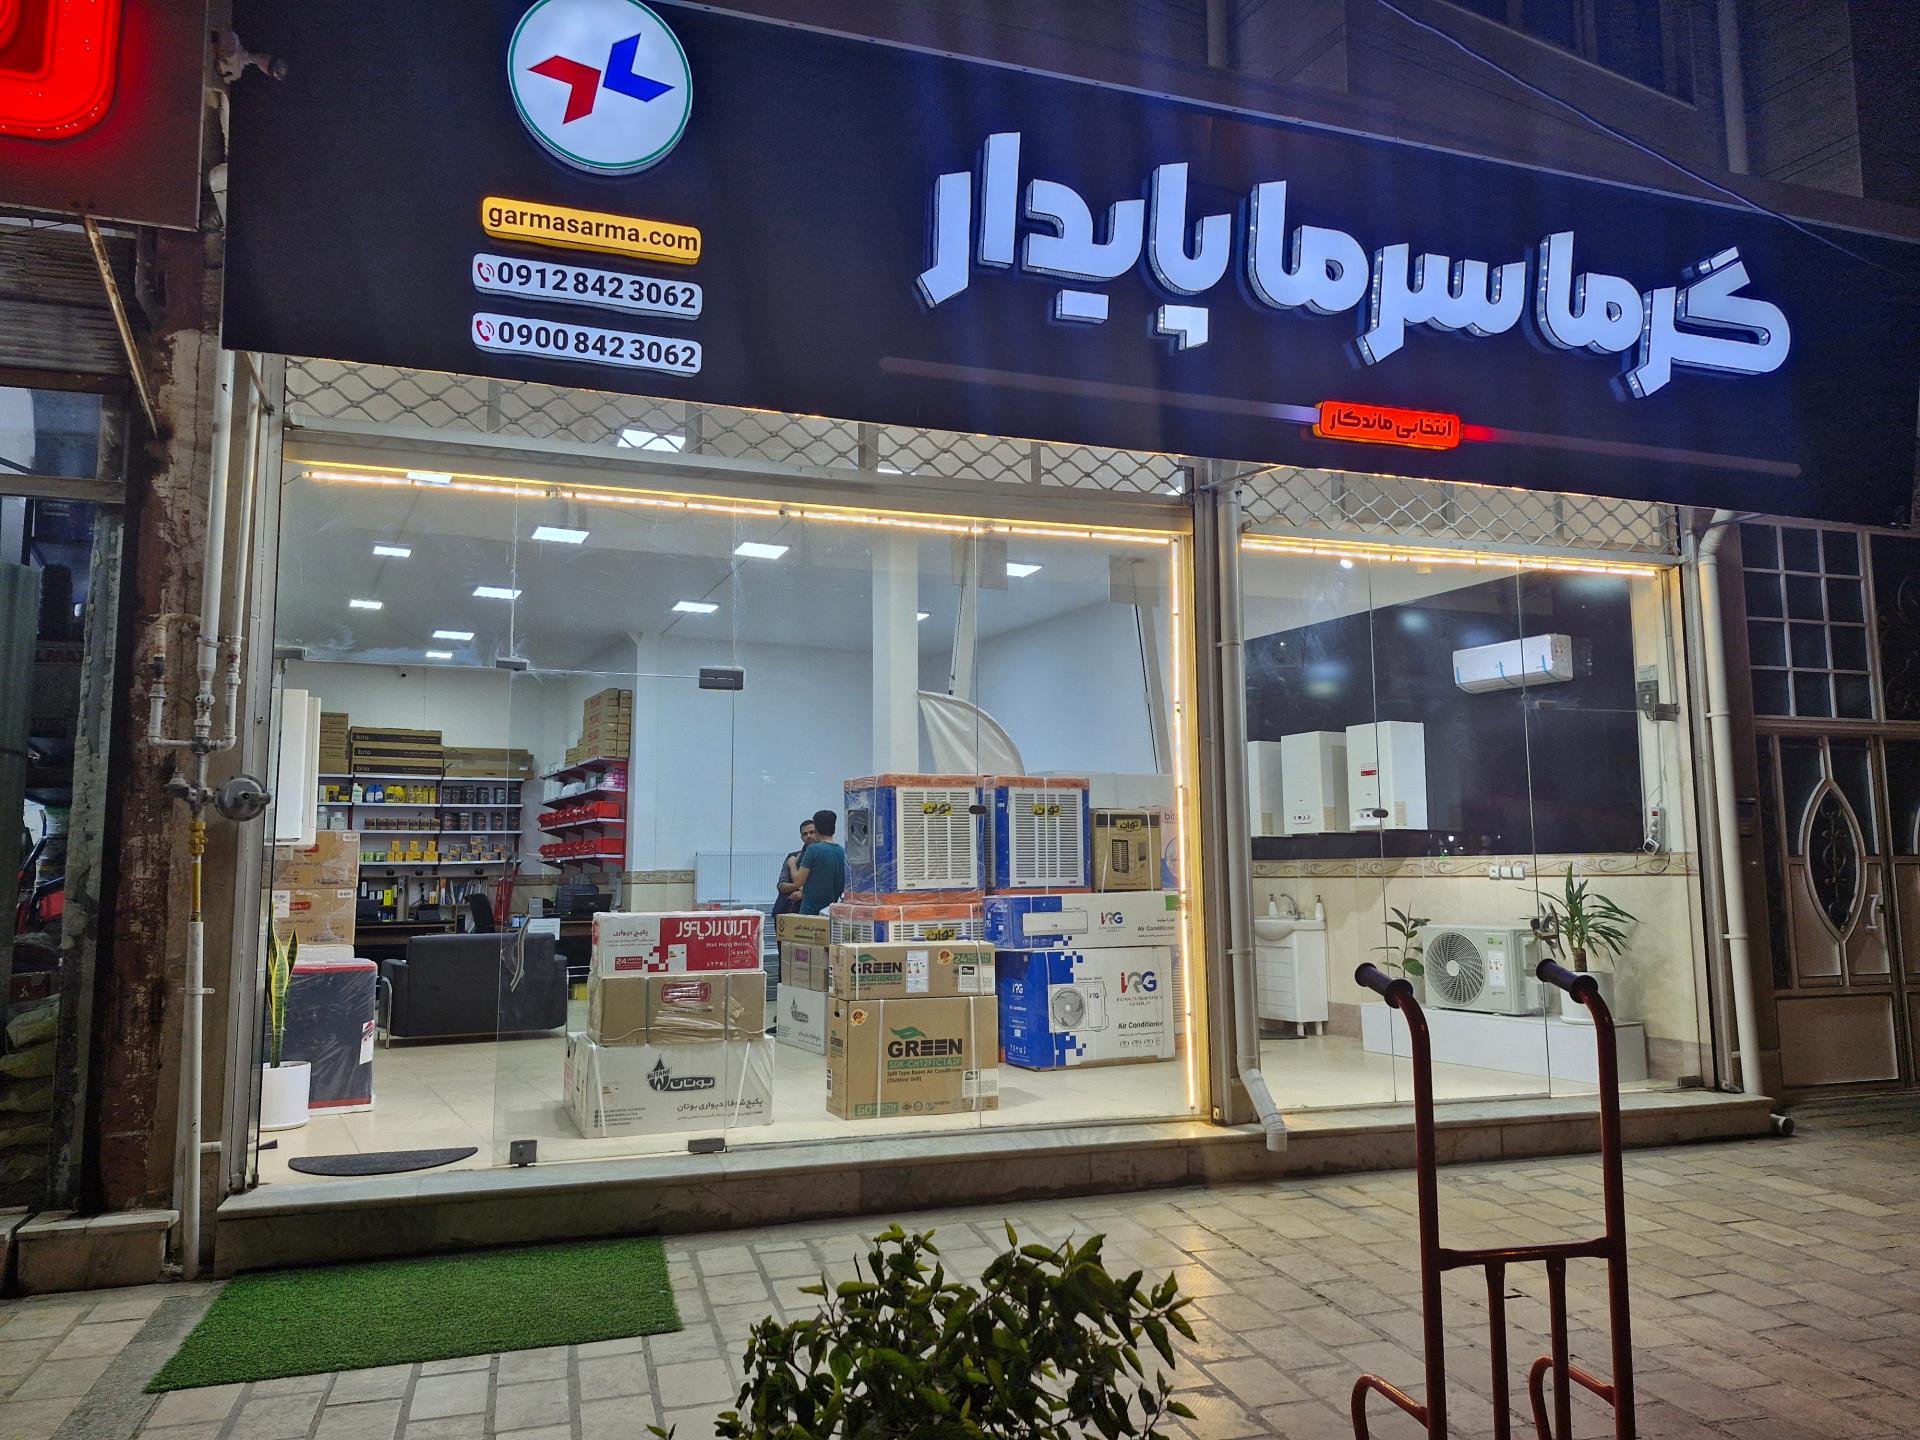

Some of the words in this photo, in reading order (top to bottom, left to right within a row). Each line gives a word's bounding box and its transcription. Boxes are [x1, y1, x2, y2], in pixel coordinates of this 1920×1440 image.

[488, 206, 698, 251] garmasarma.com
[916, 132, 1231, 351] پایدار
[1250, 181, 1525, 366] سرما
[1537, 231, 1791, 398] گرما
[1329, 407, 1393, 431] ماندگار
[1396, 417, 1452, 439] انتخابی
[616, 957, 627, 965] 24
[954, 954, 966, 963] 24
[850, 962, 902, 975] GREEN
[1118, 1022, 1127, 1030] Air
[1128, 1021, 1164, 1029] Conditioner
[887, 1038, 963, 1058] GREEN
[670, 1077, 714, 1090] بوتان
[676, 1103, 698, 1112] بوتان
[698, 1101, 724, 1110] دیواری
